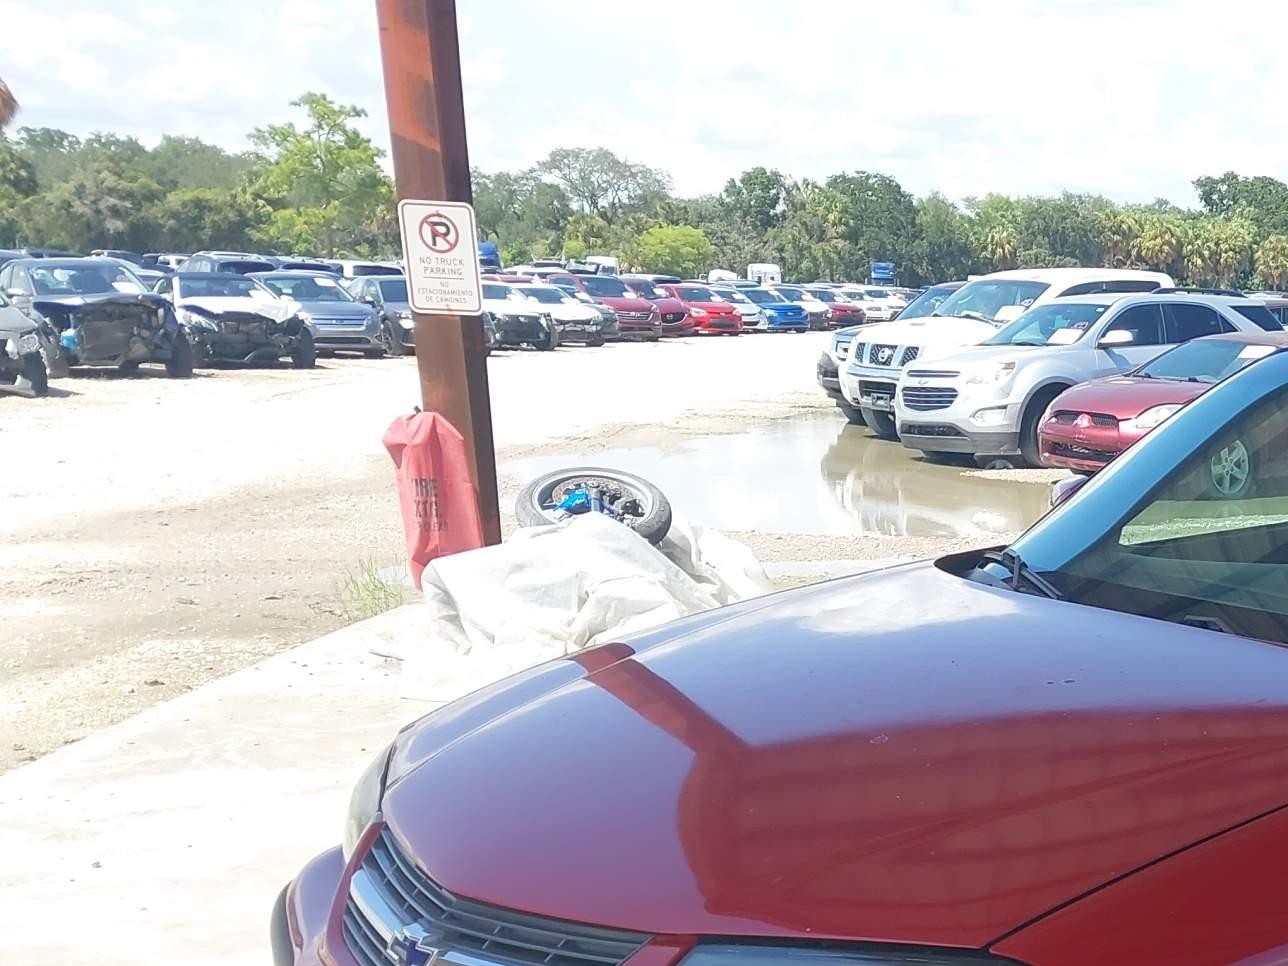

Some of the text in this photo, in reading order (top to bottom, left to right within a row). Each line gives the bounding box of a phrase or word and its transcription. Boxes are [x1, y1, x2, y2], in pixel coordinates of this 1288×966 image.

[419, 256, 465, 266] NO TRUCK
[423, 266, 463, 276] PARKING
[417, 287, 473, 297] ESTACIONAMIENTO
[425, 295, 468, 304] DE CAMIONES
[411, 479, 439, 497] IRE
